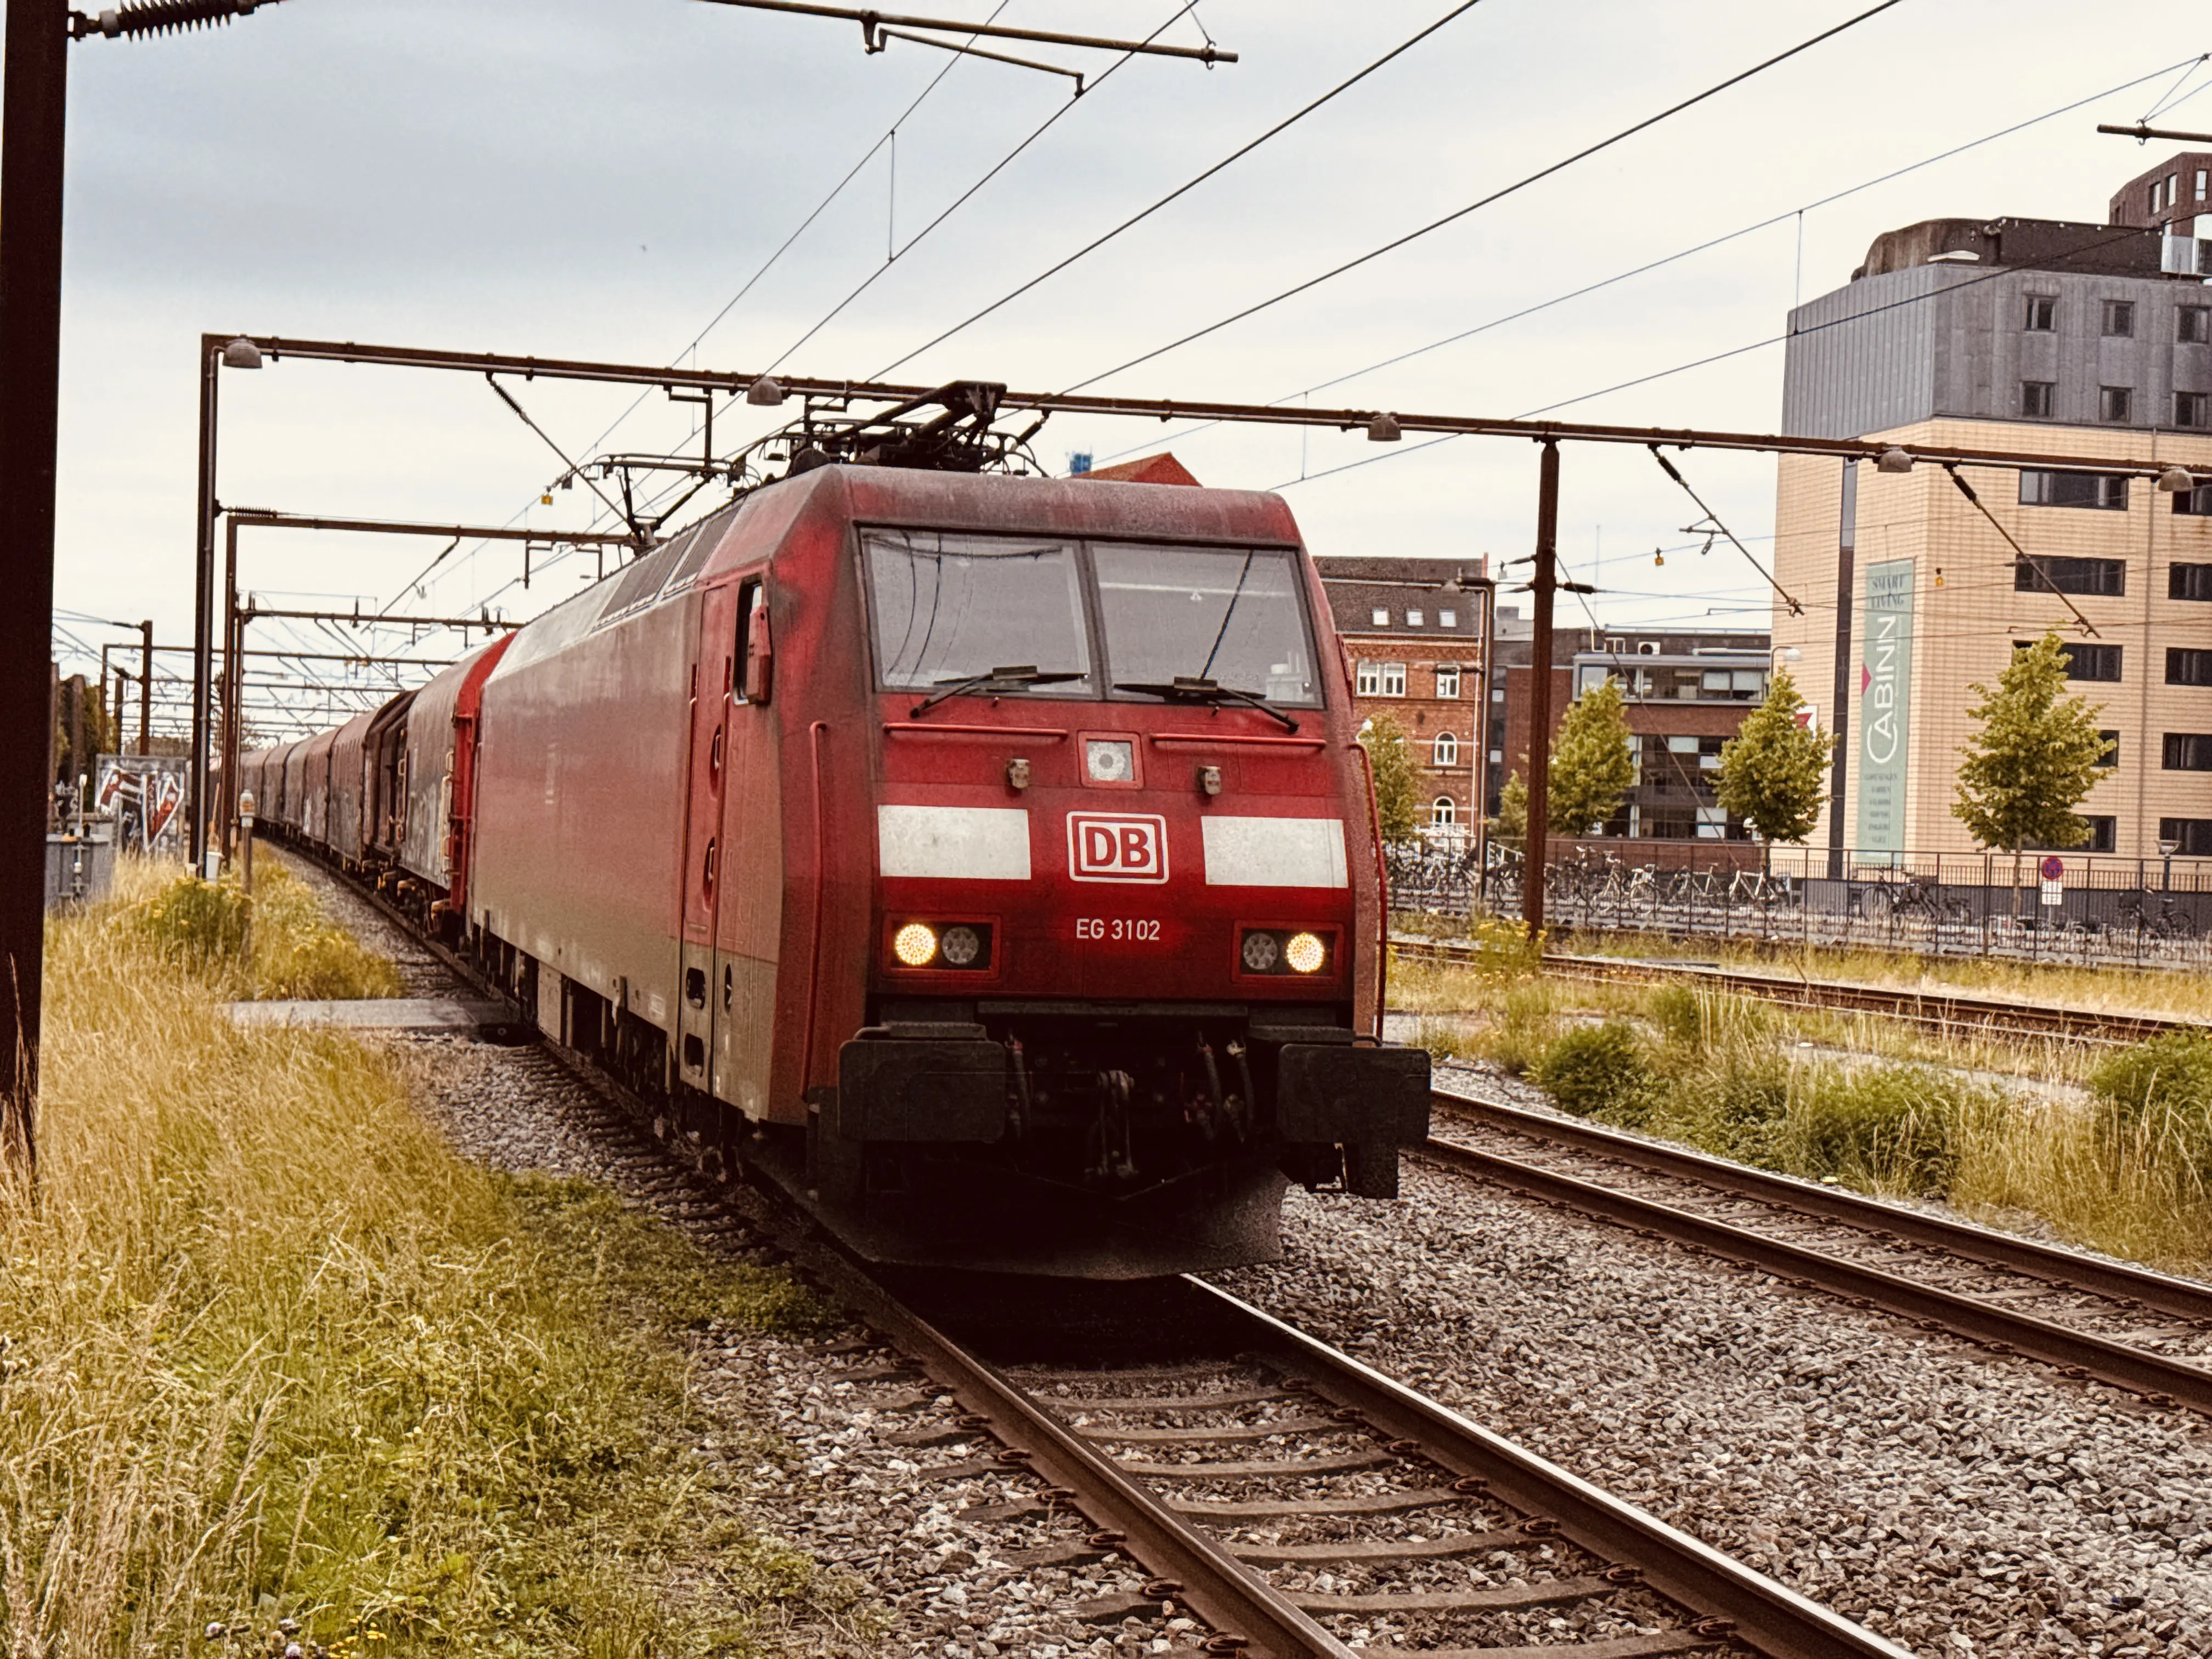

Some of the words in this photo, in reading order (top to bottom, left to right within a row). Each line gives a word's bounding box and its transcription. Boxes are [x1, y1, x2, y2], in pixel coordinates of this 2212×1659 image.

[1866, 615, 1898, 764] CABINN
[1085, 826, 1150, 867] DB
[1076, 918, 1105, 939] EG
[1110, 918, 1160, 940] 3102
